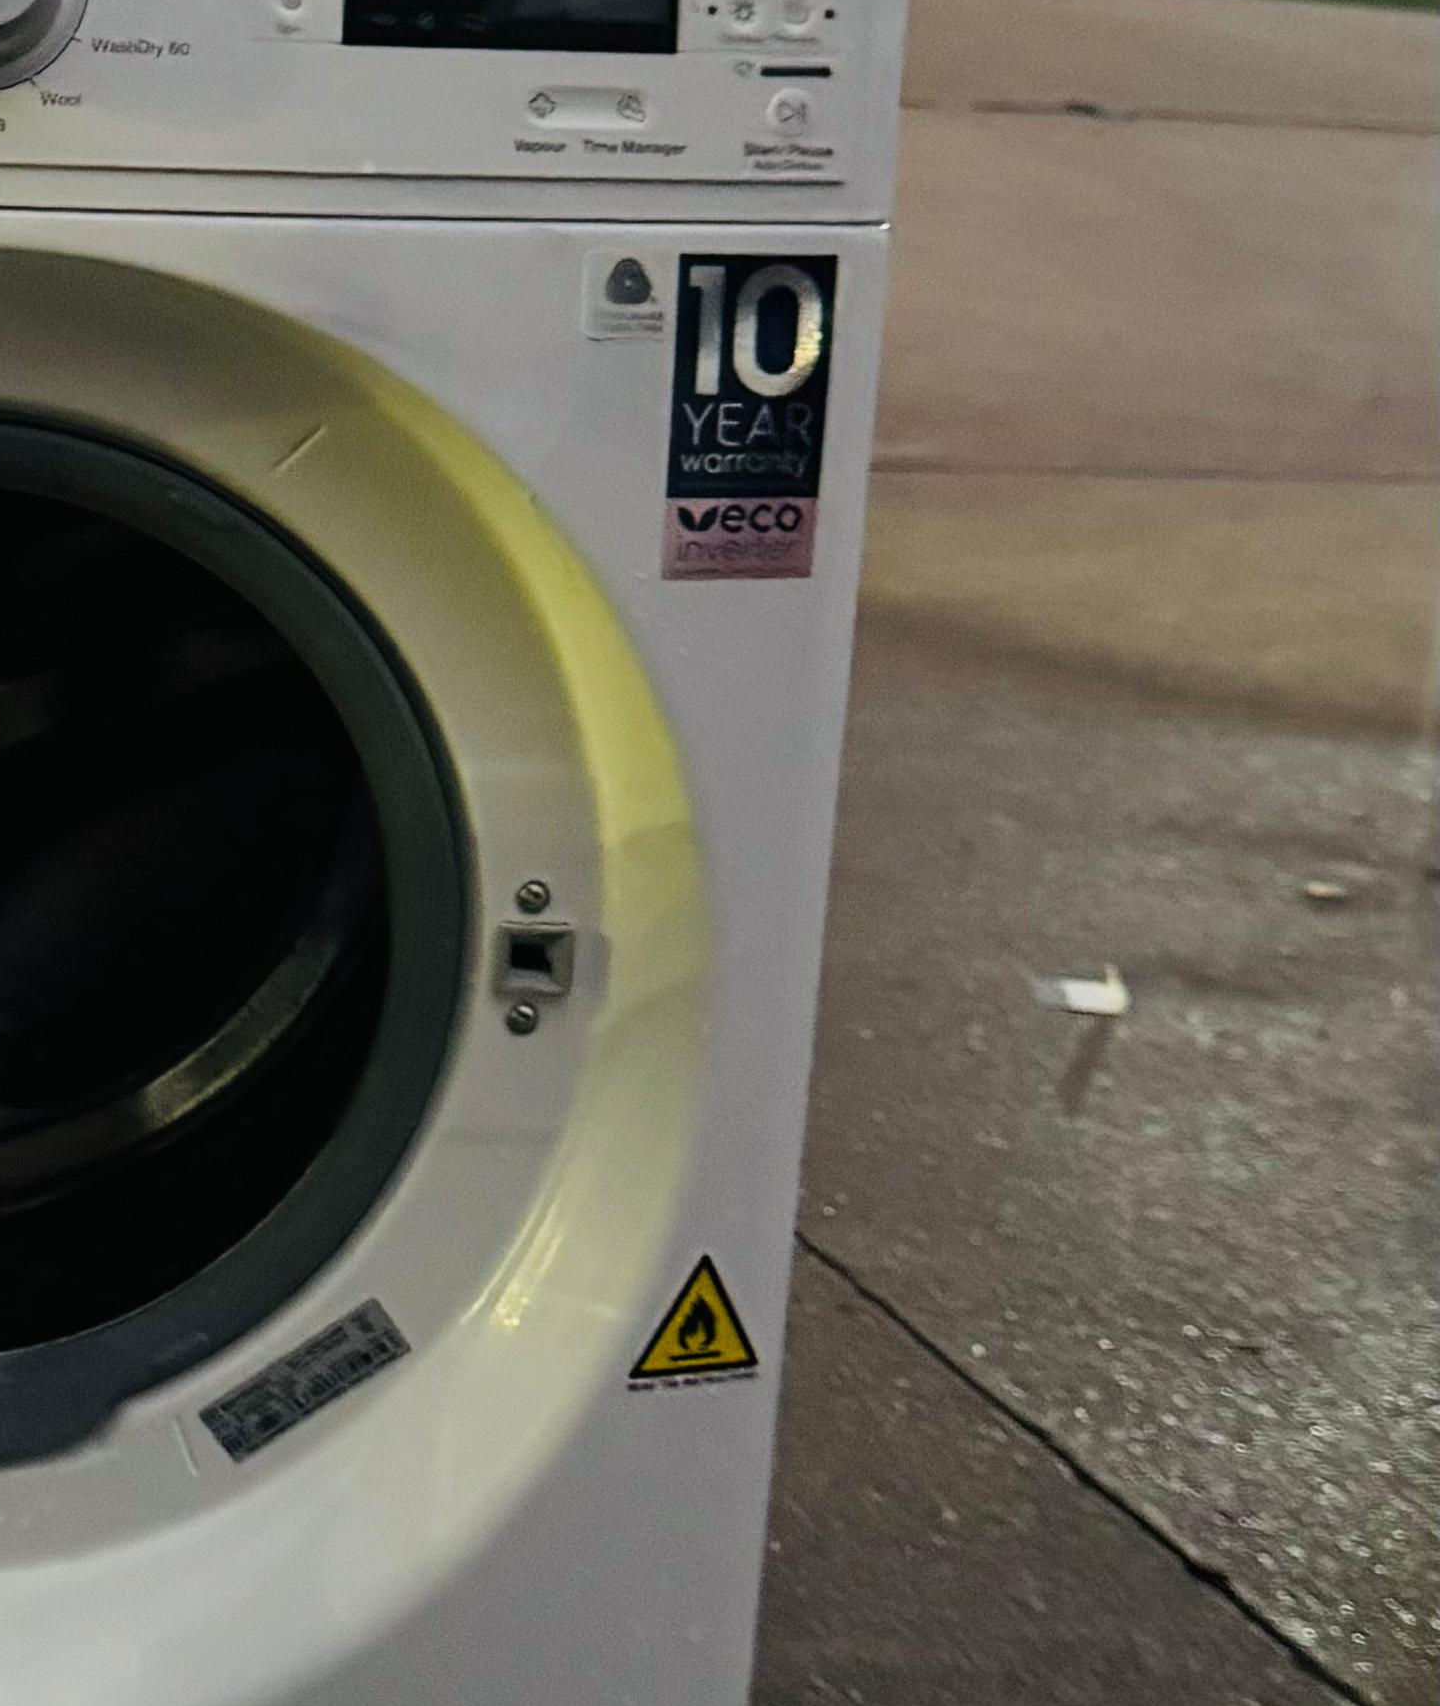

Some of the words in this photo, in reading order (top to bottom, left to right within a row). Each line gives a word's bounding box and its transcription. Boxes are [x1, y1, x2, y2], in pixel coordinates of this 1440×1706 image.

[40, 91, 82, 107] Wool
[514, 139, 567, 154] Vapour
[582, 139, 618, 154] Time
[621, 140, 687, 157] Manager
[688, 263, 823, 397] 10
[682, 402, 813, 447] YEAR
[680, 453, 811, 479] warranty
[720, 504, 804, 534] eco
